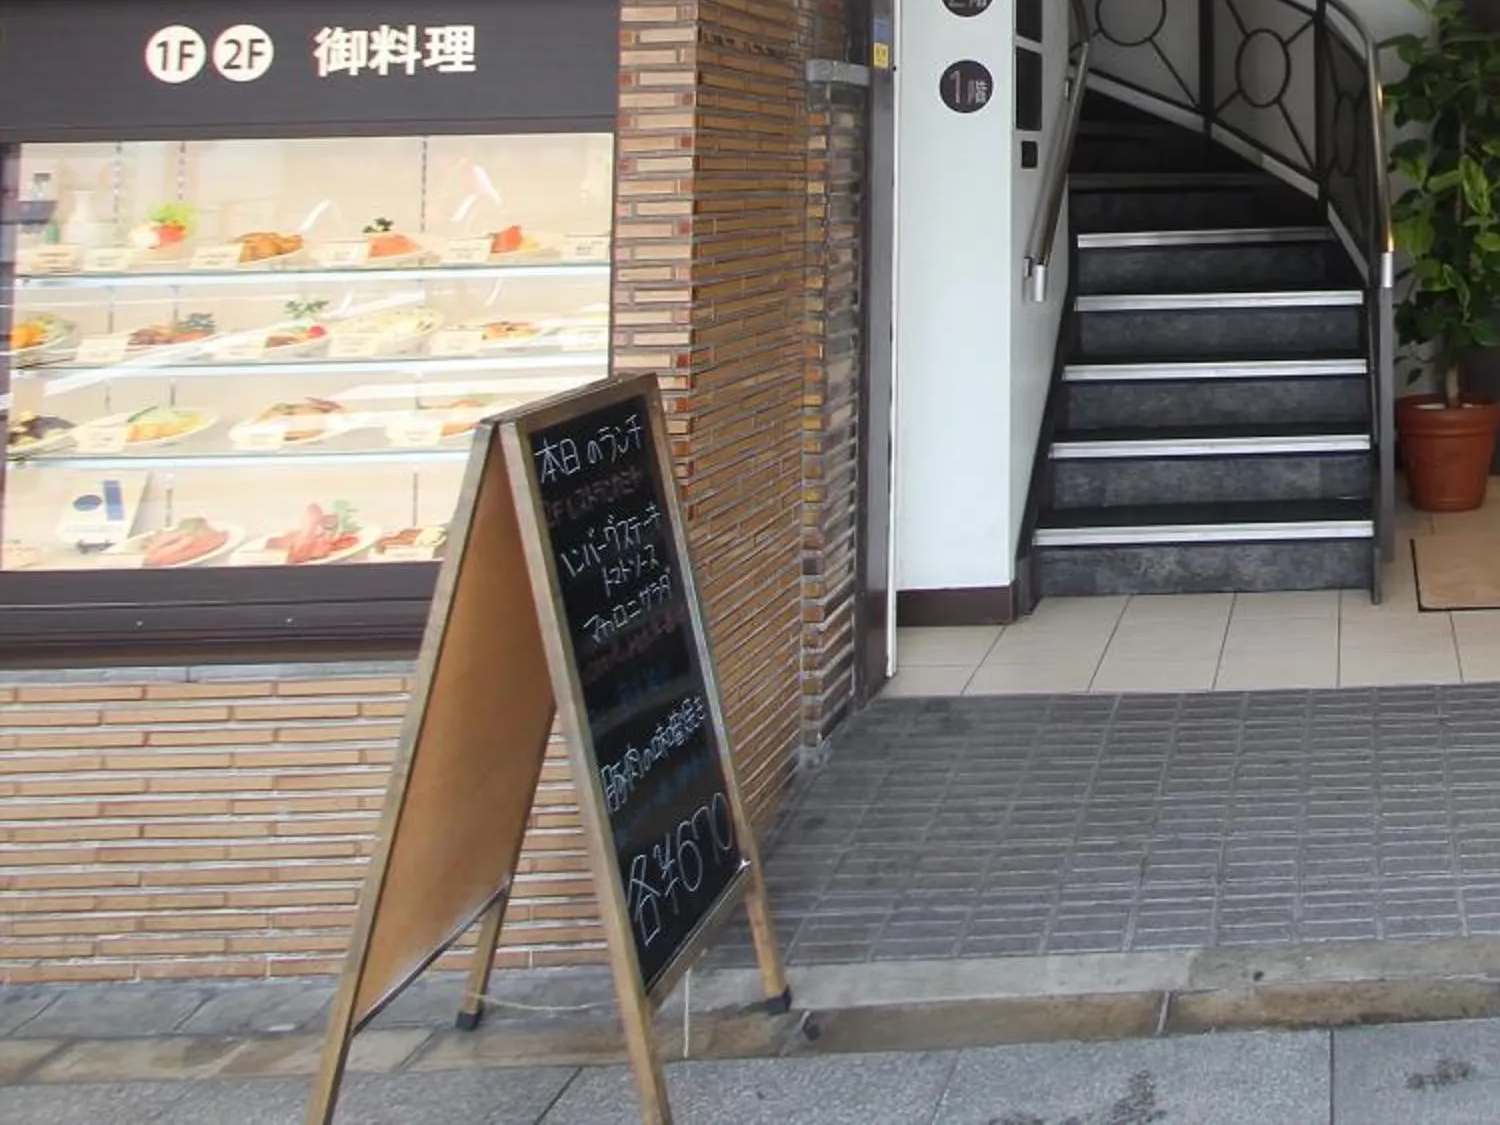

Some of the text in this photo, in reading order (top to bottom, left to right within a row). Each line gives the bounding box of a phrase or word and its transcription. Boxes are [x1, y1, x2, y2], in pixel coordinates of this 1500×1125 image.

[155, 24, 477, 77] 1F 2F 御料理
[950, 69, 989, 105] 1階
